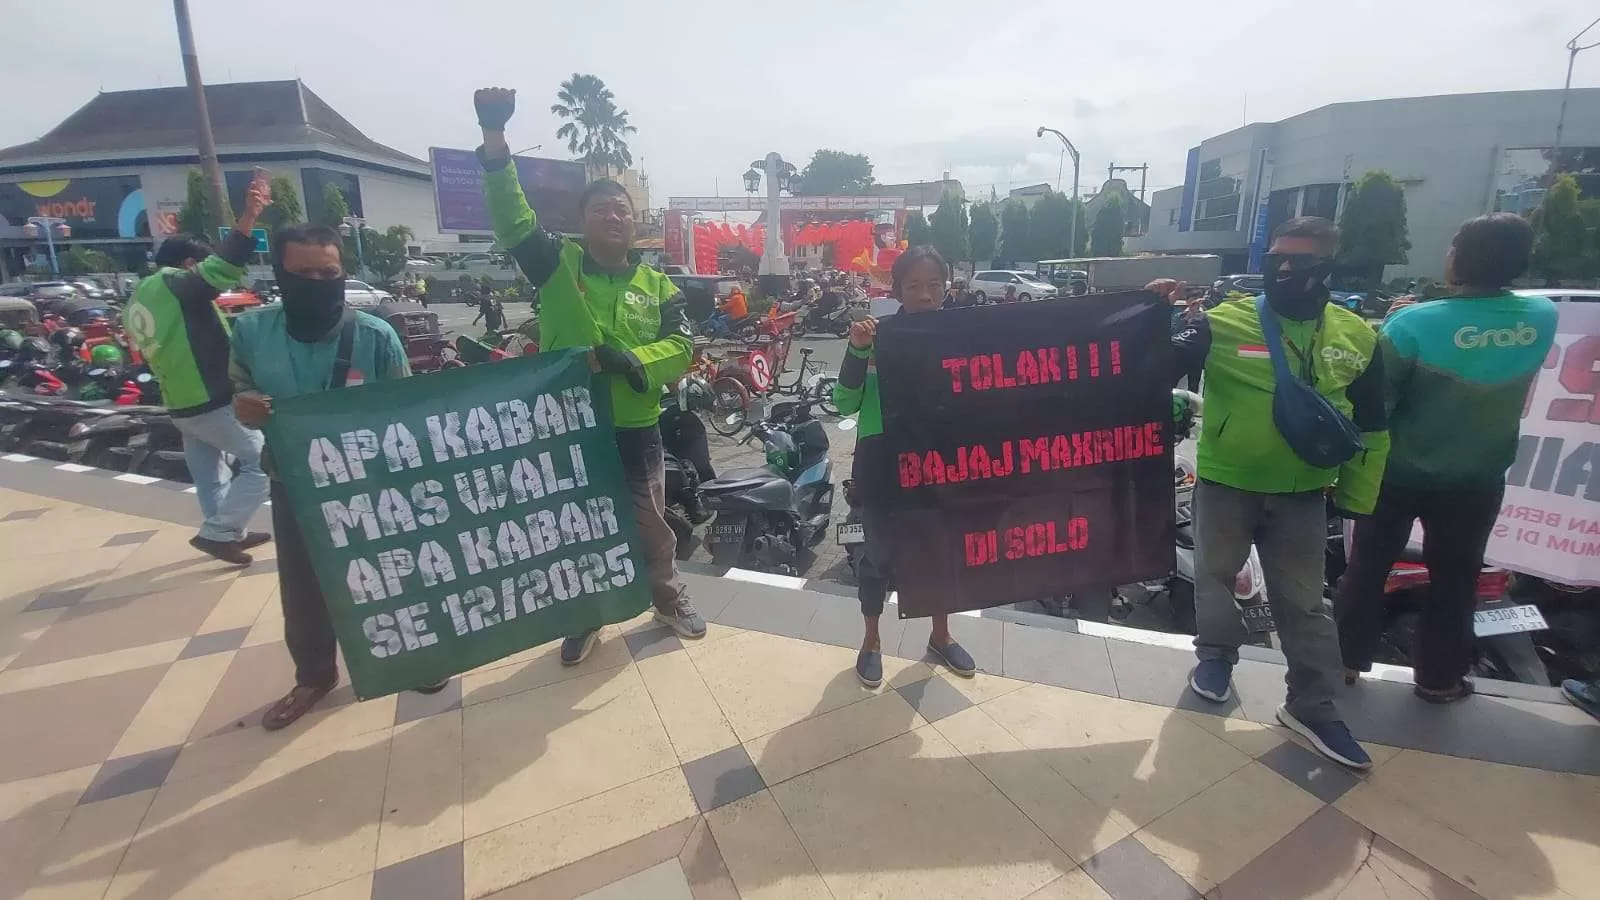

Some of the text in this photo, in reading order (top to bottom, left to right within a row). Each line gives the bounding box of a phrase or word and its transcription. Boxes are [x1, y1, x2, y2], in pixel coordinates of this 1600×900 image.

[624, 291, 660, 309] goje
[1454, 322, 1538, 349] Grab
[308, 385, 597, 488] APA KABAR
[898, 421, 1164, 488] BAJAJ MAXRIDE
[321, 443, 589, 548] MAS WALI
[346, 496, 619, 604] APA KABAR
[964, 517, 1089, 567] DI SOLO
[362, 543, 636, 659] SE 12/2025
